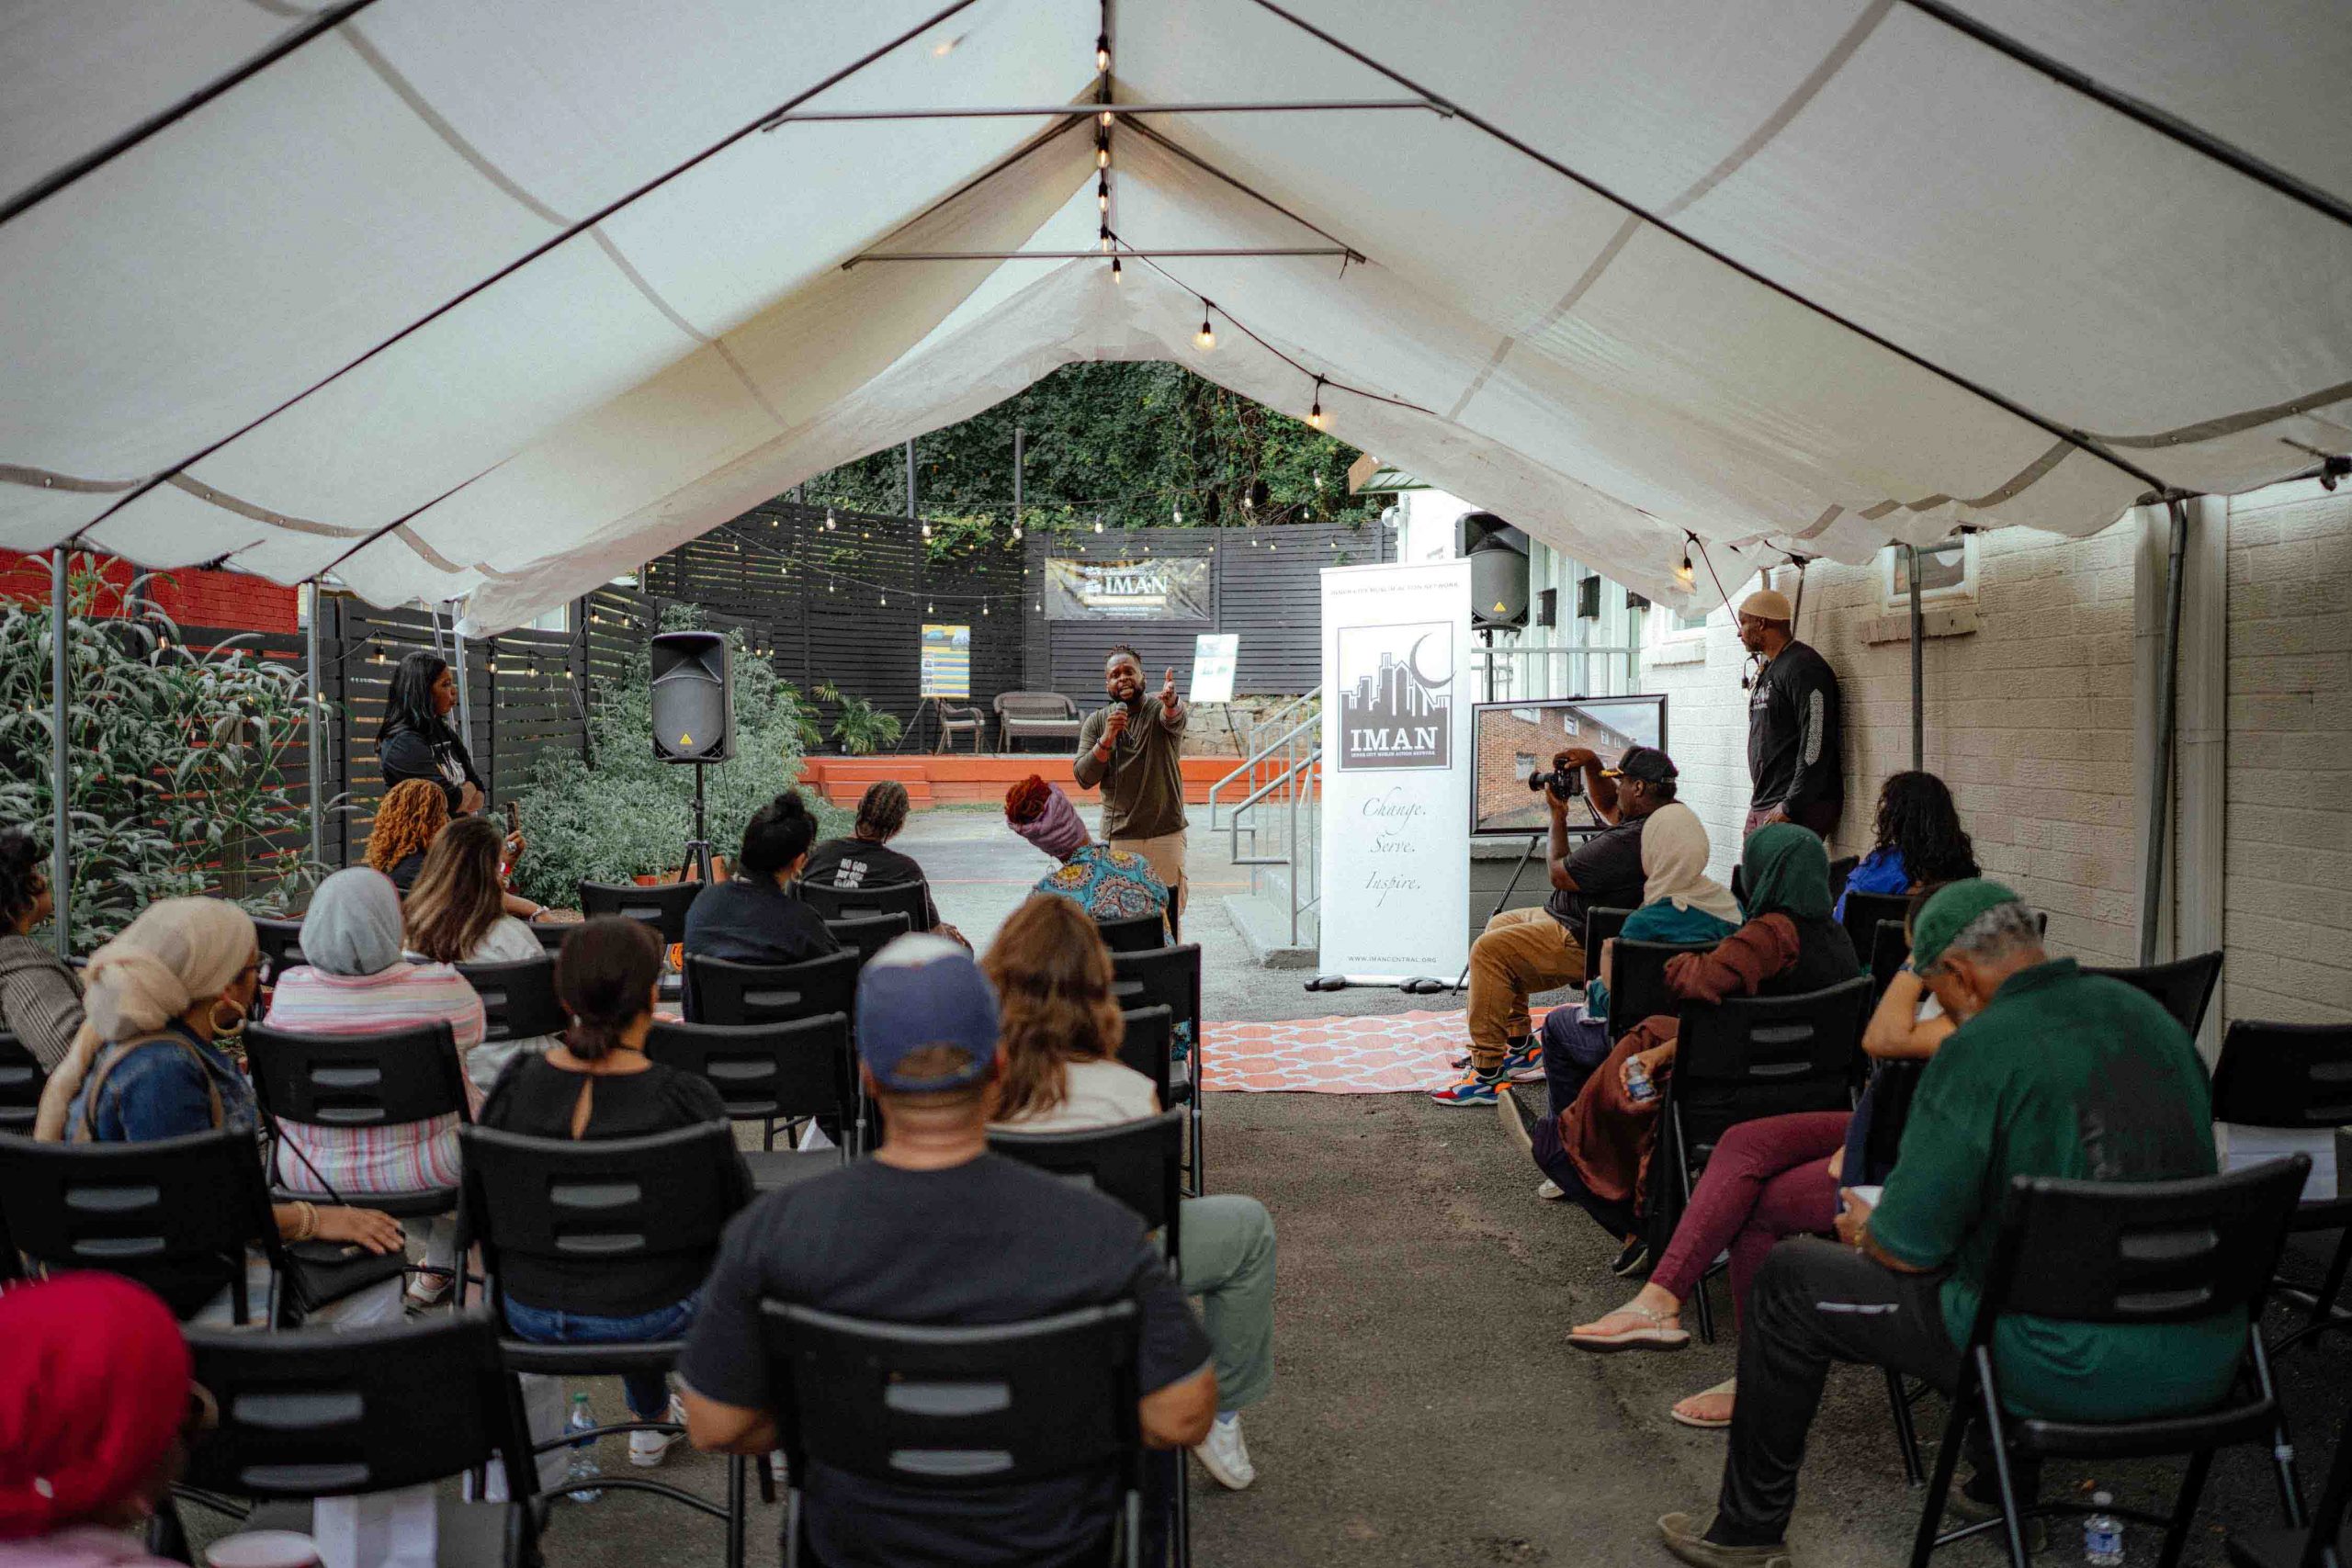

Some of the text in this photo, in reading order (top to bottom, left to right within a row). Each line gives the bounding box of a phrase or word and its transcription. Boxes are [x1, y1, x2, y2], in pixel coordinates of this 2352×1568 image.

[1105, 576, 1168, 594] IMAN
[1351, 727, 1439, 751] IMAN
[1363, 786, 1427, 836] Change.
[1368, 832, 1416, 853] Serve.
[1365, 871, 1421, 908] Inspire.
